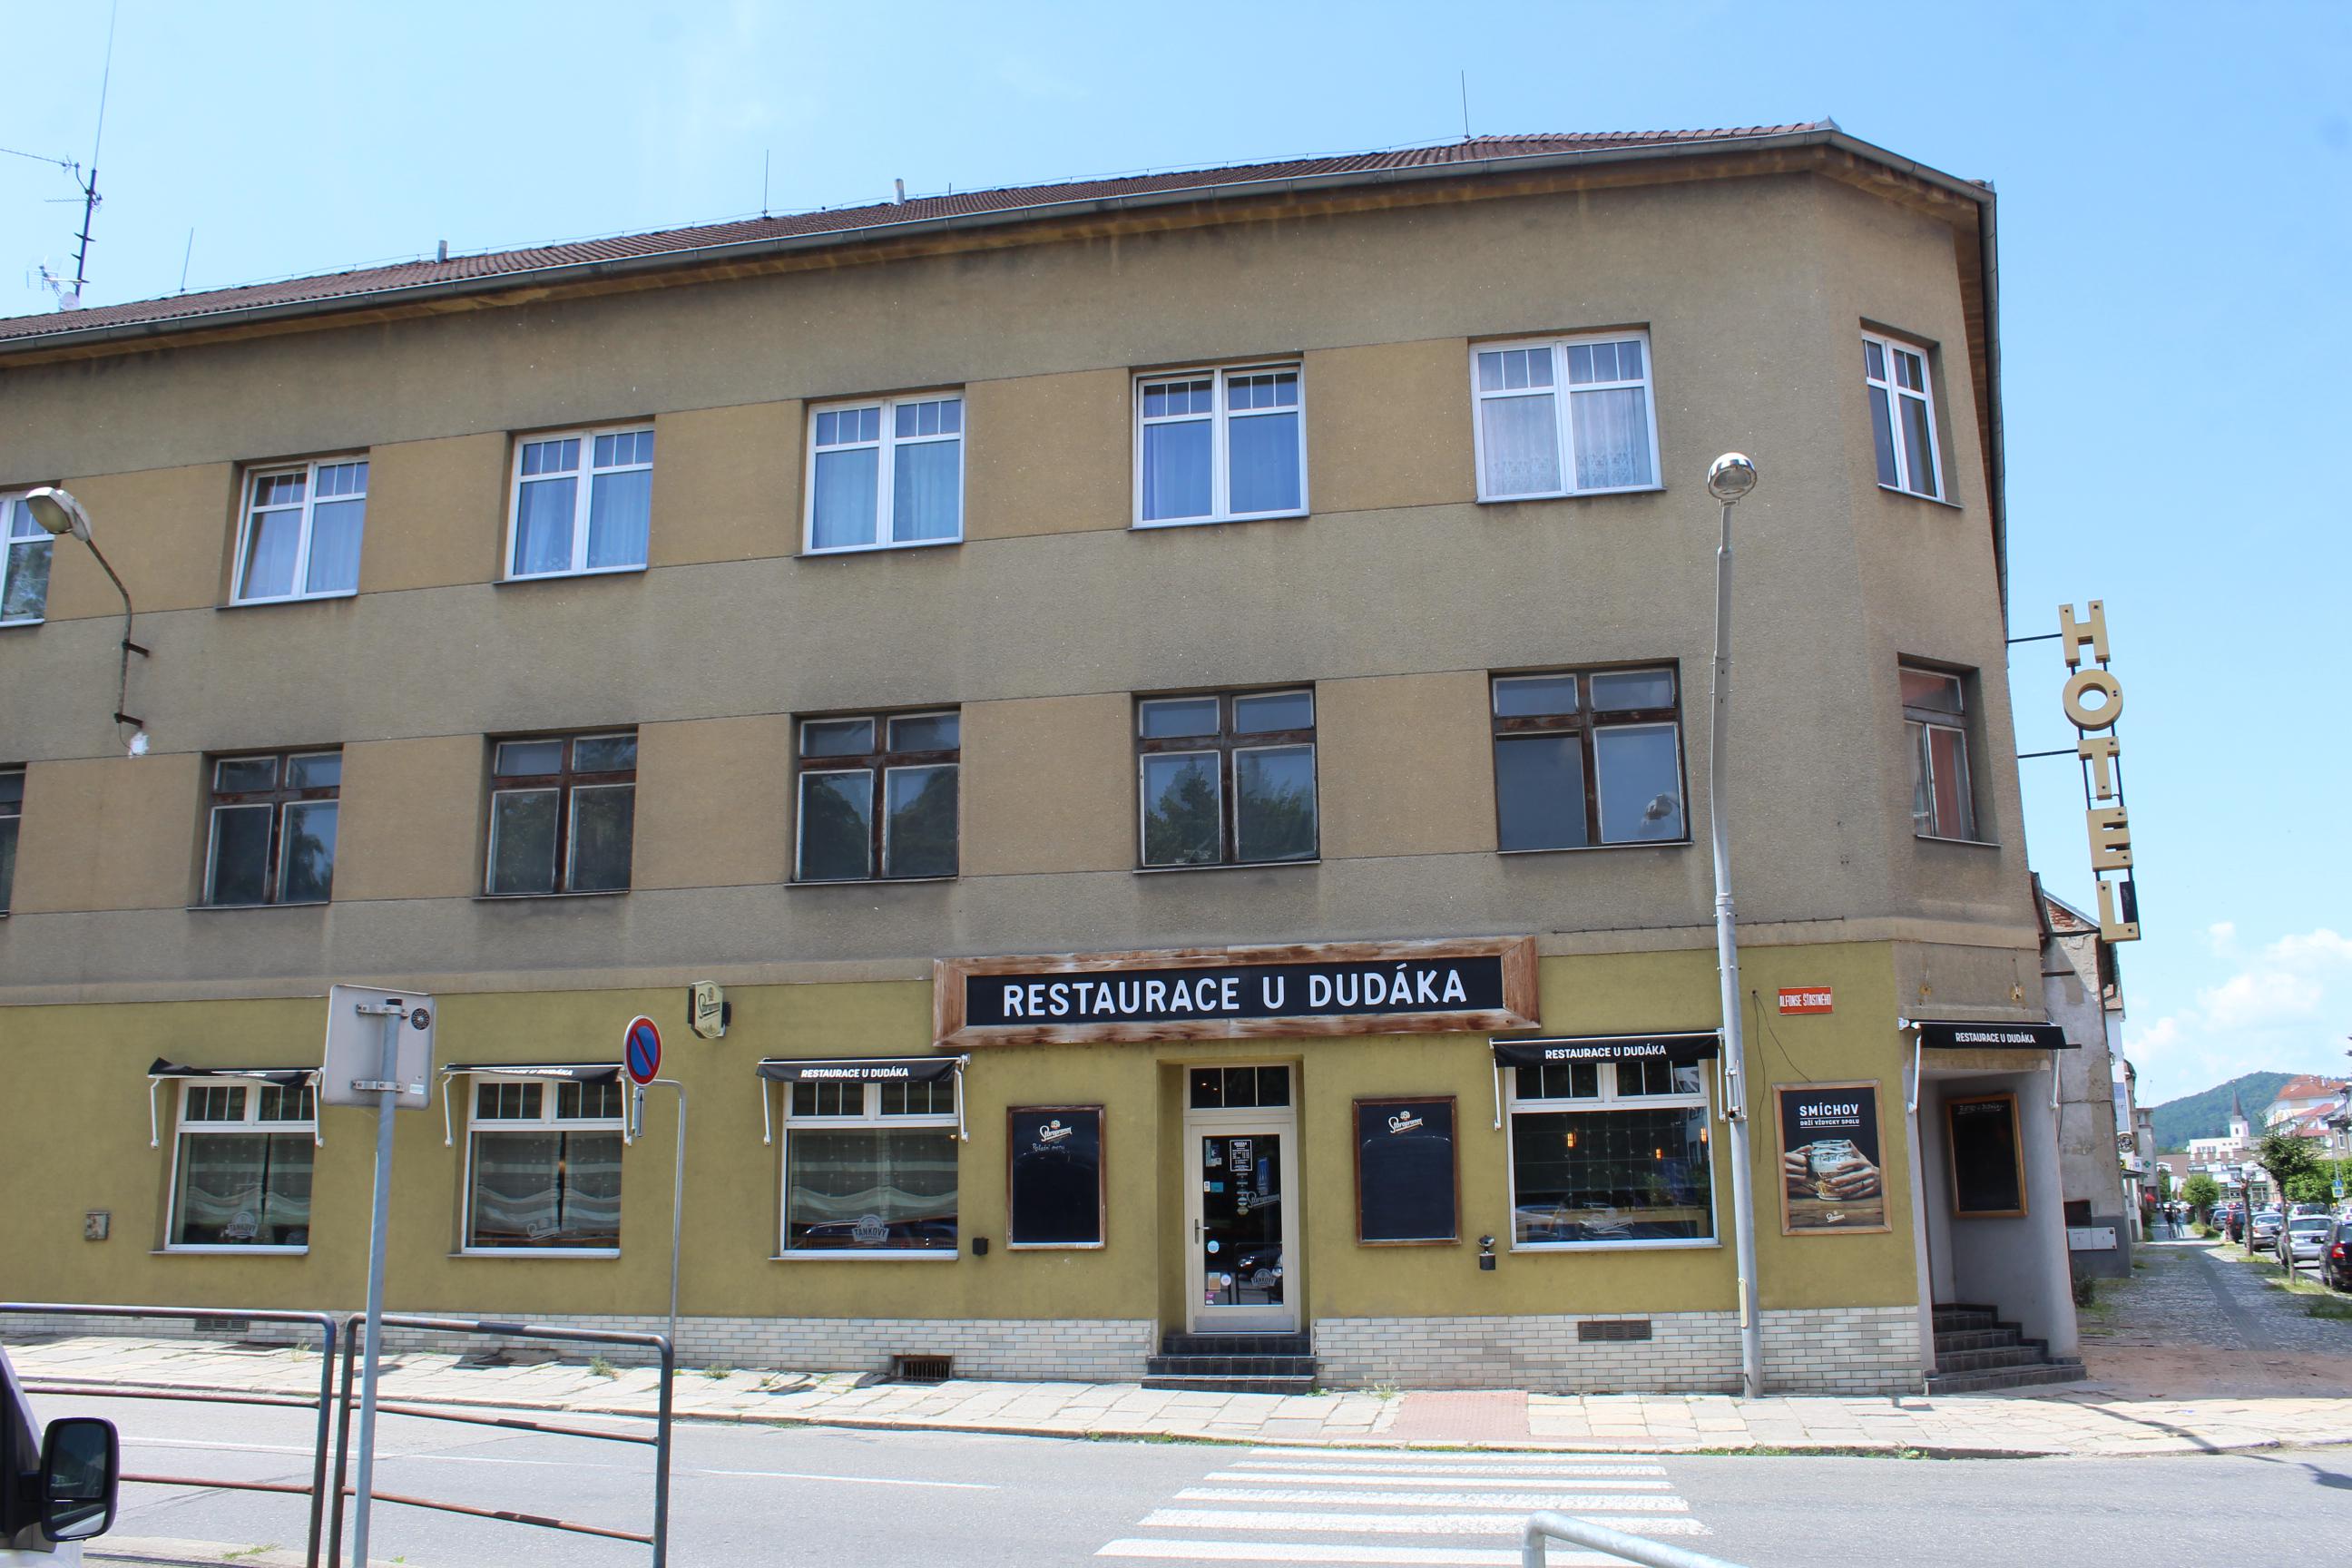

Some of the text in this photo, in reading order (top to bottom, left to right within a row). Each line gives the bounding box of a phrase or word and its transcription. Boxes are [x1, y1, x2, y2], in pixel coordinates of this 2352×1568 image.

[2059, 600, 2141, 944] HOTEL
[1004, 963, 1468, 1017] RESTAURACE U DUDÁKA
[1955, 1032, 2036, 1044] RESTAURACE U DUDÁKA
[1544, 1043, 1667, 1060] RESTAURACE U DUDÁKA
[800, 1066, 909, 1079] RESTAURACE U DUDÁKA
[1799, 1102, 1859, 1117] SMÍCHOV
